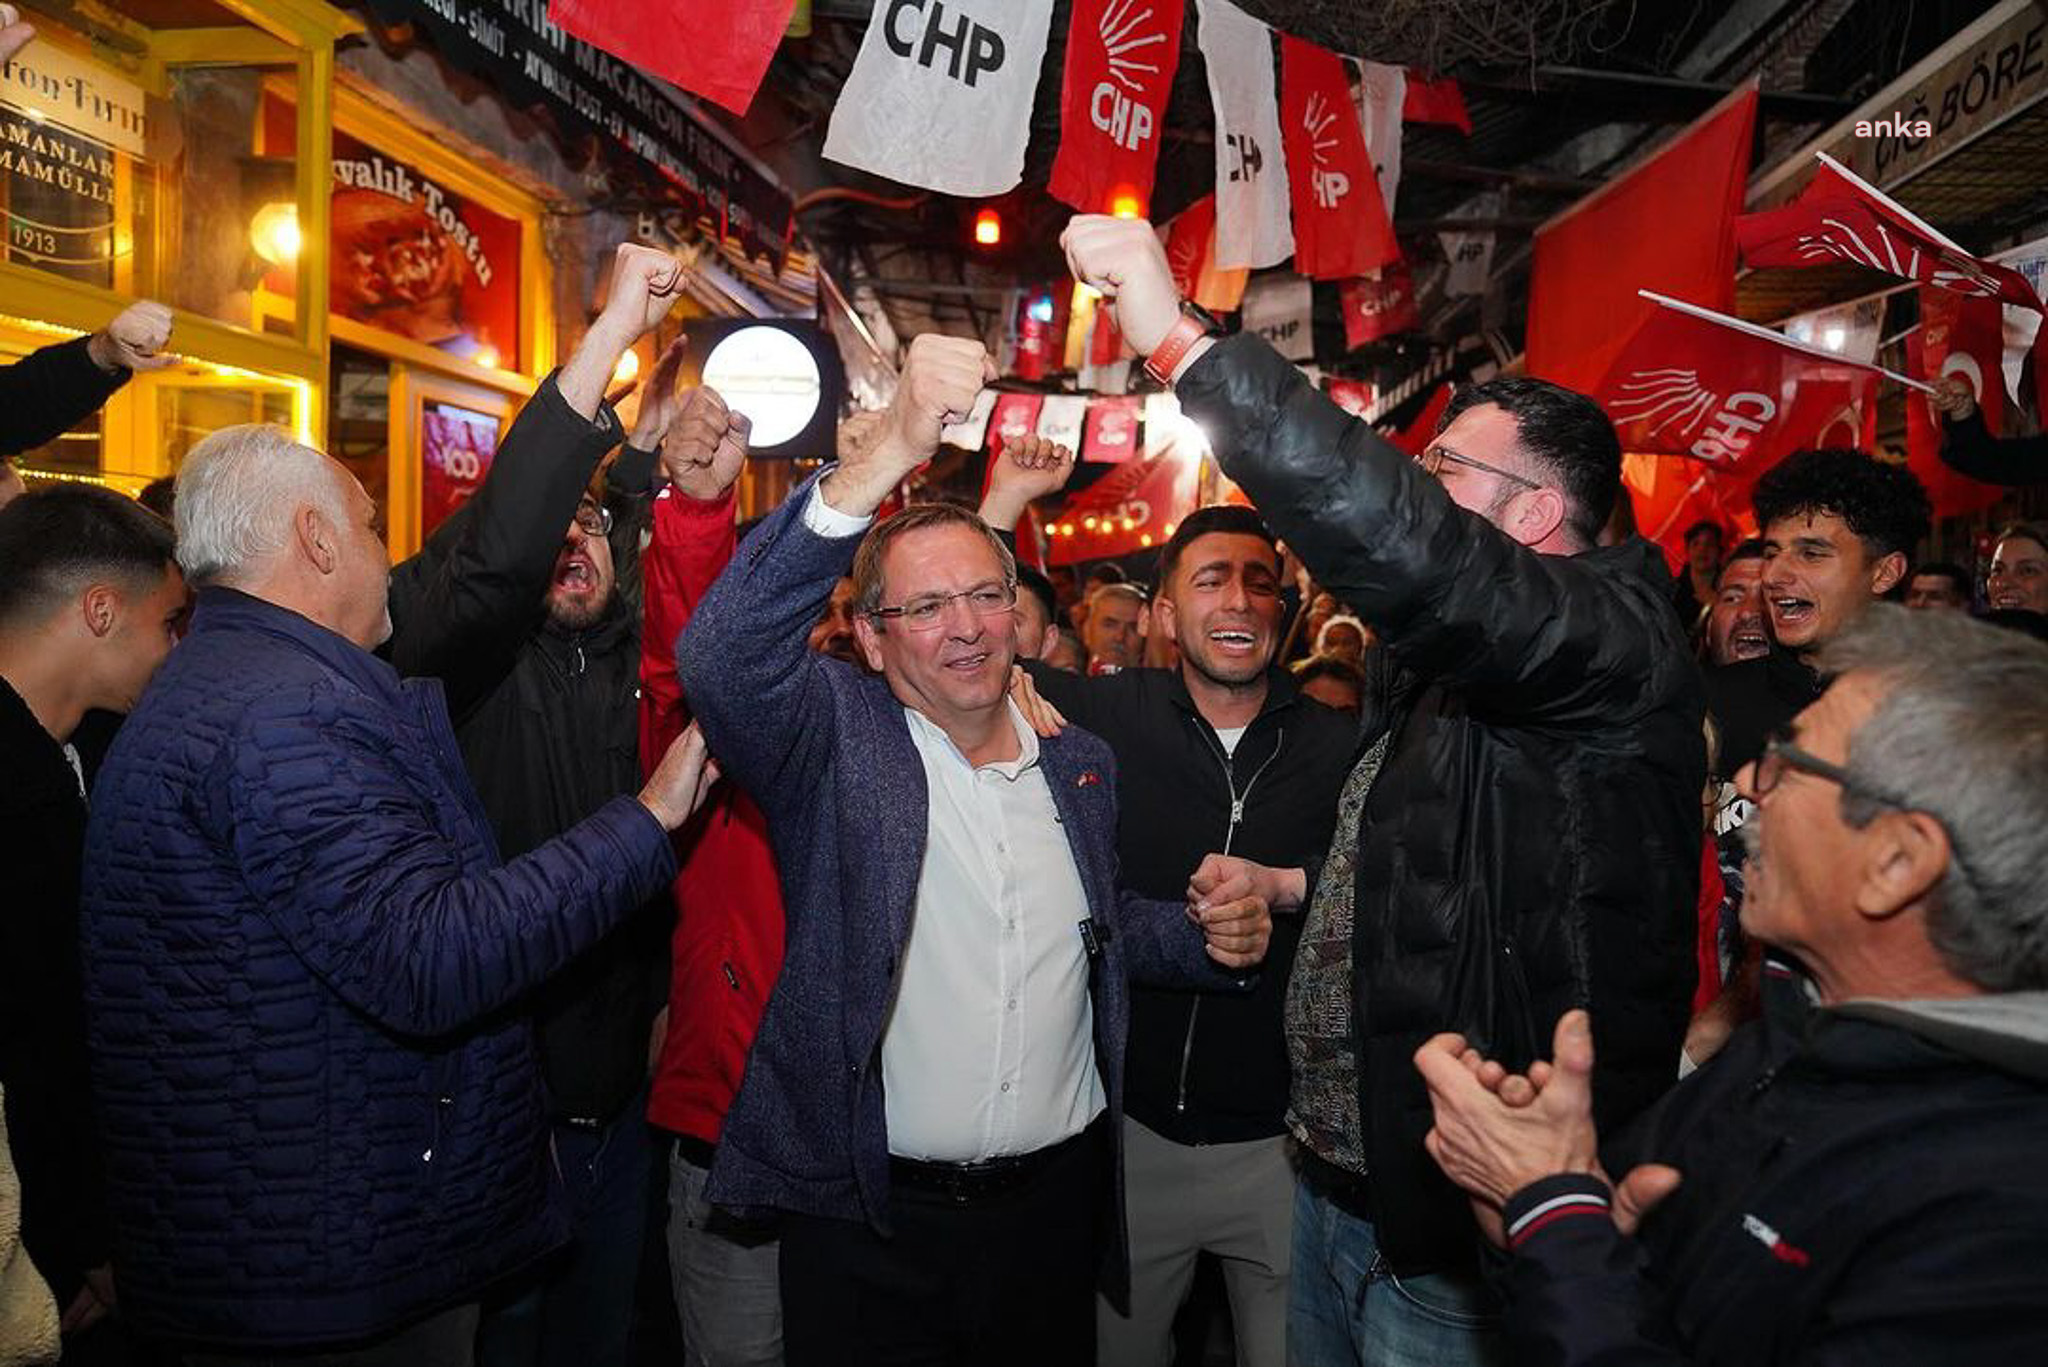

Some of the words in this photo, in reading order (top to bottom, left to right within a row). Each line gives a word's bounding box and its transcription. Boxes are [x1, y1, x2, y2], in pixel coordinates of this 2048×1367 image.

[884, 0, 1005, 87] CHP
[1091, 82, 1152, 151] CHP
[0, 122, 114, 179] MANLAR
[1312, 166, 1350, 210] HP
[14, 224, 56, 254] 1913
